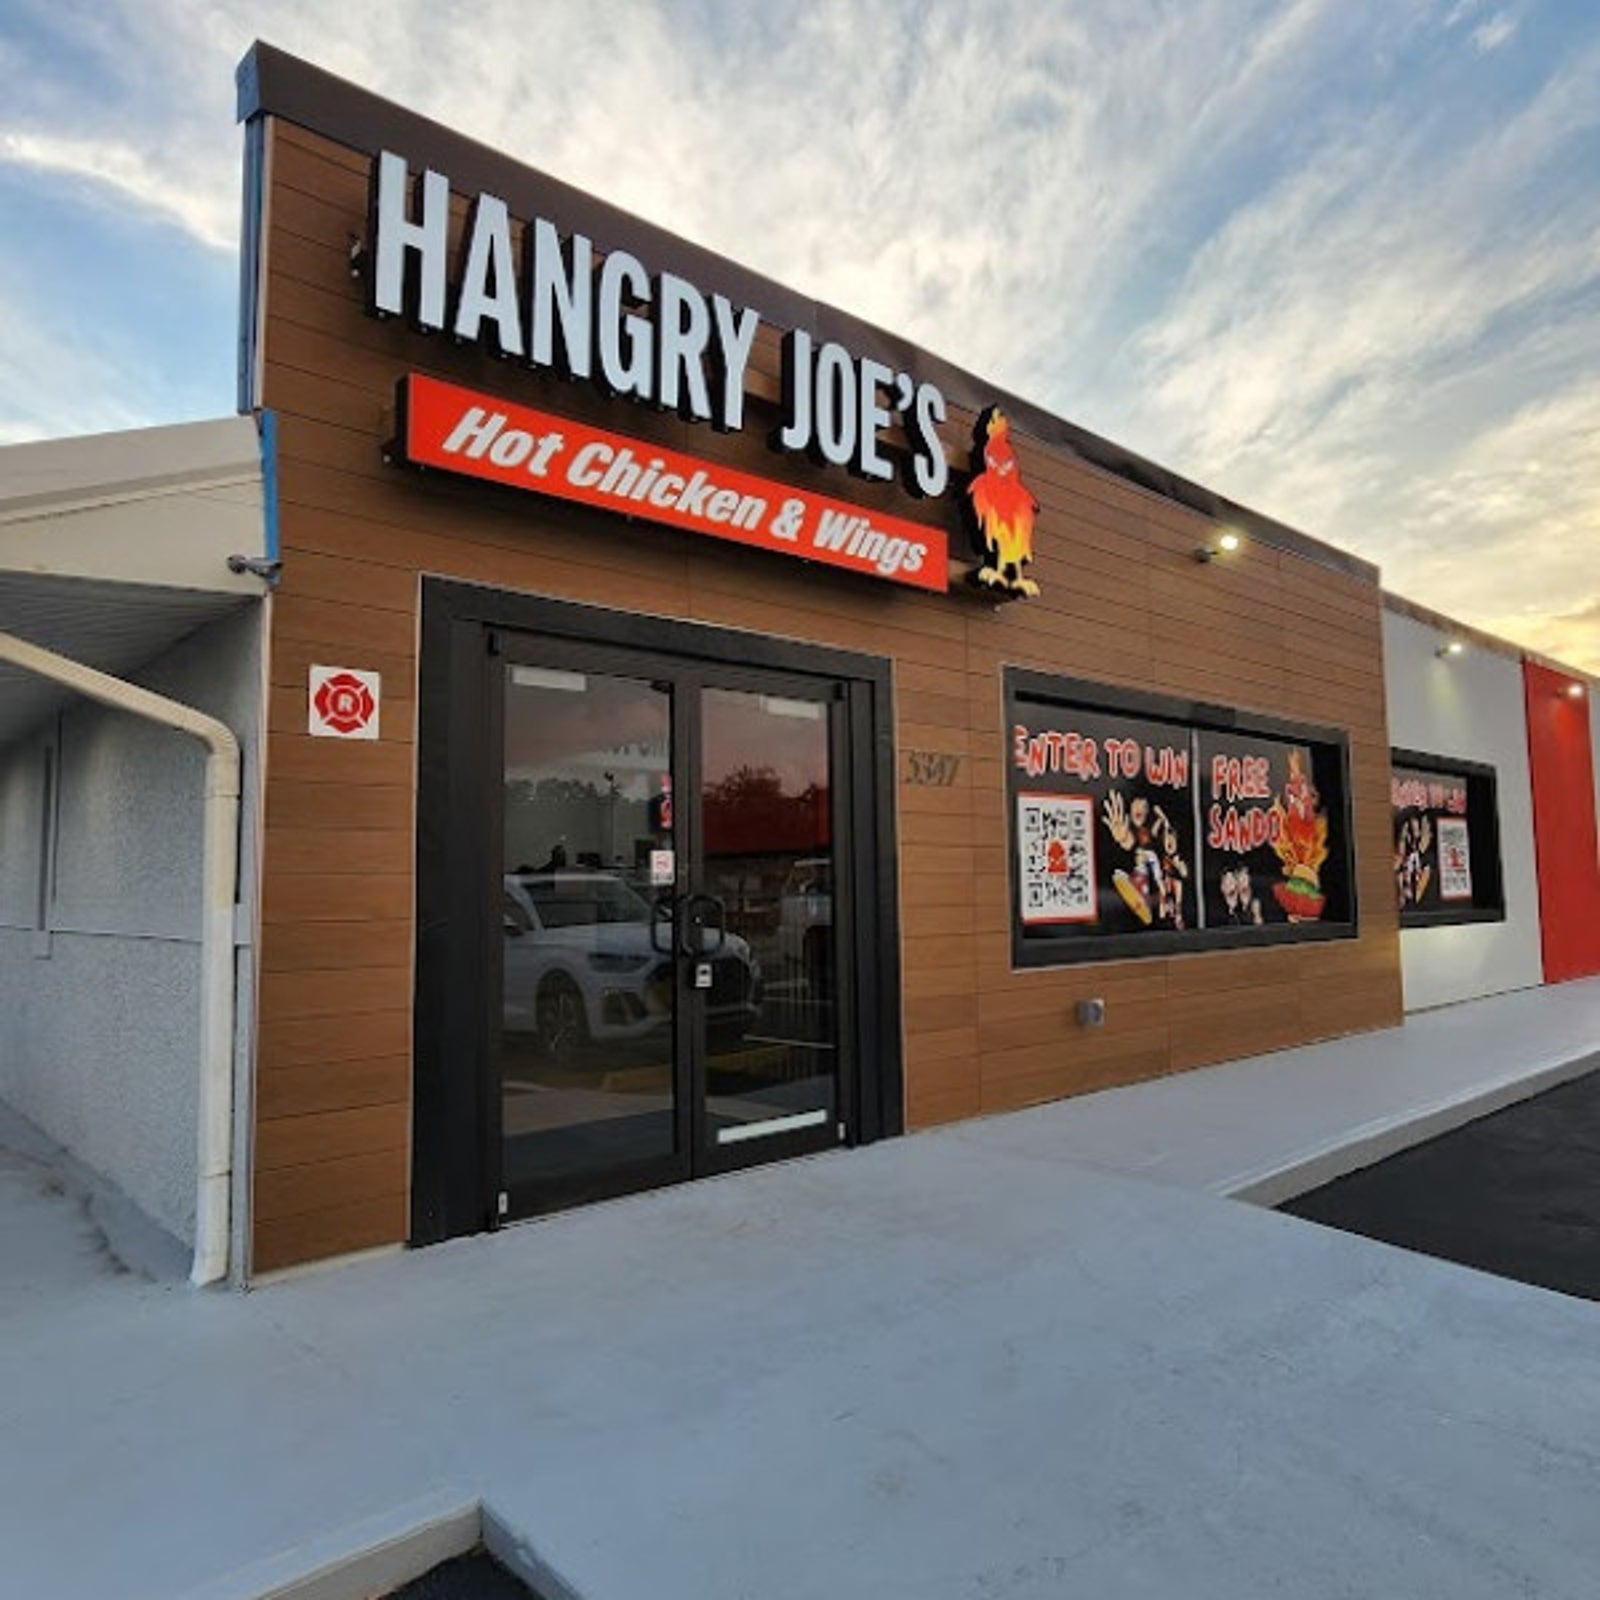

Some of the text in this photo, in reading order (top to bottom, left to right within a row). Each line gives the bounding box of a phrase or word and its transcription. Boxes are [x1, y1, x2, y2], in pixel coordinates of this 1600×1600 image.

[375, 149, 949, 498] HANGRY JOE'S
[442, 406, 928, 576] Hot Chicken & Wings
[337, 693, 354, 713] R
[1013, 724, 1189, 789] ENTER TO WIN
[1211, 755, 1271, 801] FREE
[1208, 802, 1284, 855] SANDO
